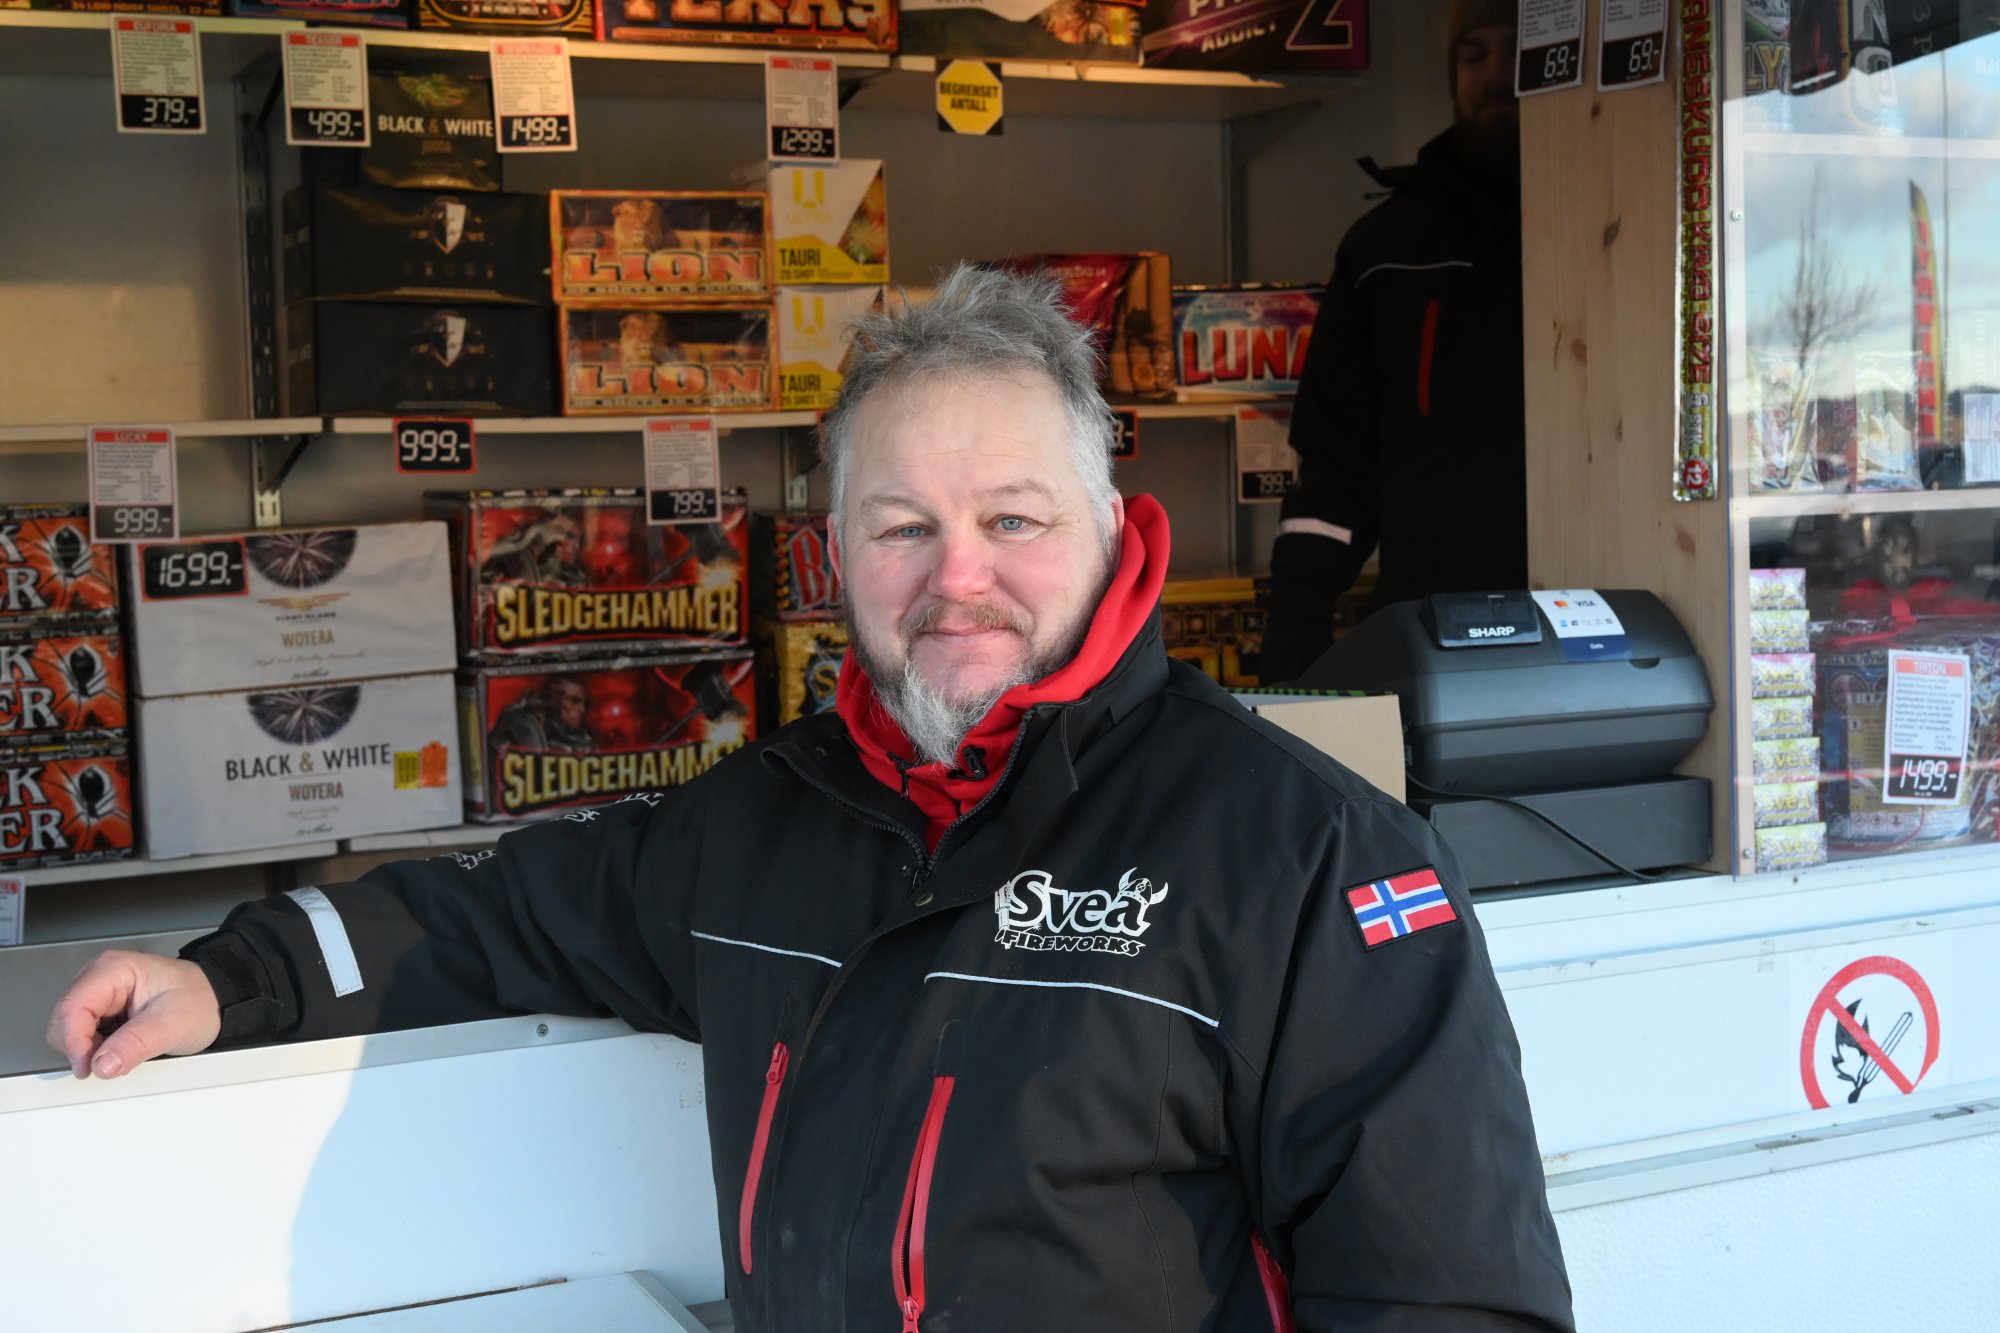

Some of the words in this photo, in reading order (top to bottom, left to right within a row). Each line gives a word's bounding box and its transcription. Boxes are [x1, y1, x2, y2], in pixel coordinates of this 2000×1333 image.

[940, 82, 998, 99] BEGRENSET
[143, 97, 197, 124] 379.-
[950, 96, 988, 112] ANTALL
[308, 110, 362, 137] 499.-
[377, 114, 425, 134] BLACK
[444, 118, 494, 138] WHITE
[511, 117, 569, 142] 1499.-
[781, 129, 833, 154] 1299.-
[564, 250, 766, 286] LION
[780, 249, 821, 267] TAURI
[570, 364, 767, 398] LION
[780, 374, 821, 393] TAURI
[400, 429, 471, 463] 999.-
[668, 490, 715, 515] 799.-
[114, 508, 171, 534] 999.-
[158, 550, 243, 588] 1699.-
[496, 578, 739, 643] SLEDGEHAMMER
[280, 629, 336, 648] WOYERA
[1468, 626, 1516, 638] SHARP
[1913, 661, 1946, 675] TRITON
[225, 753, 293, 781] BLACK
[299, 751, 315, 773] &
[322, 743, 392, 771] WHITE
[1900, 758, 1957, 793] 1499.-
[288, 782, 345, 802] WOYERA
[1009, 869, 1151, 937] Svea
[1000, 928, 1147, 957] FIREWORKS
